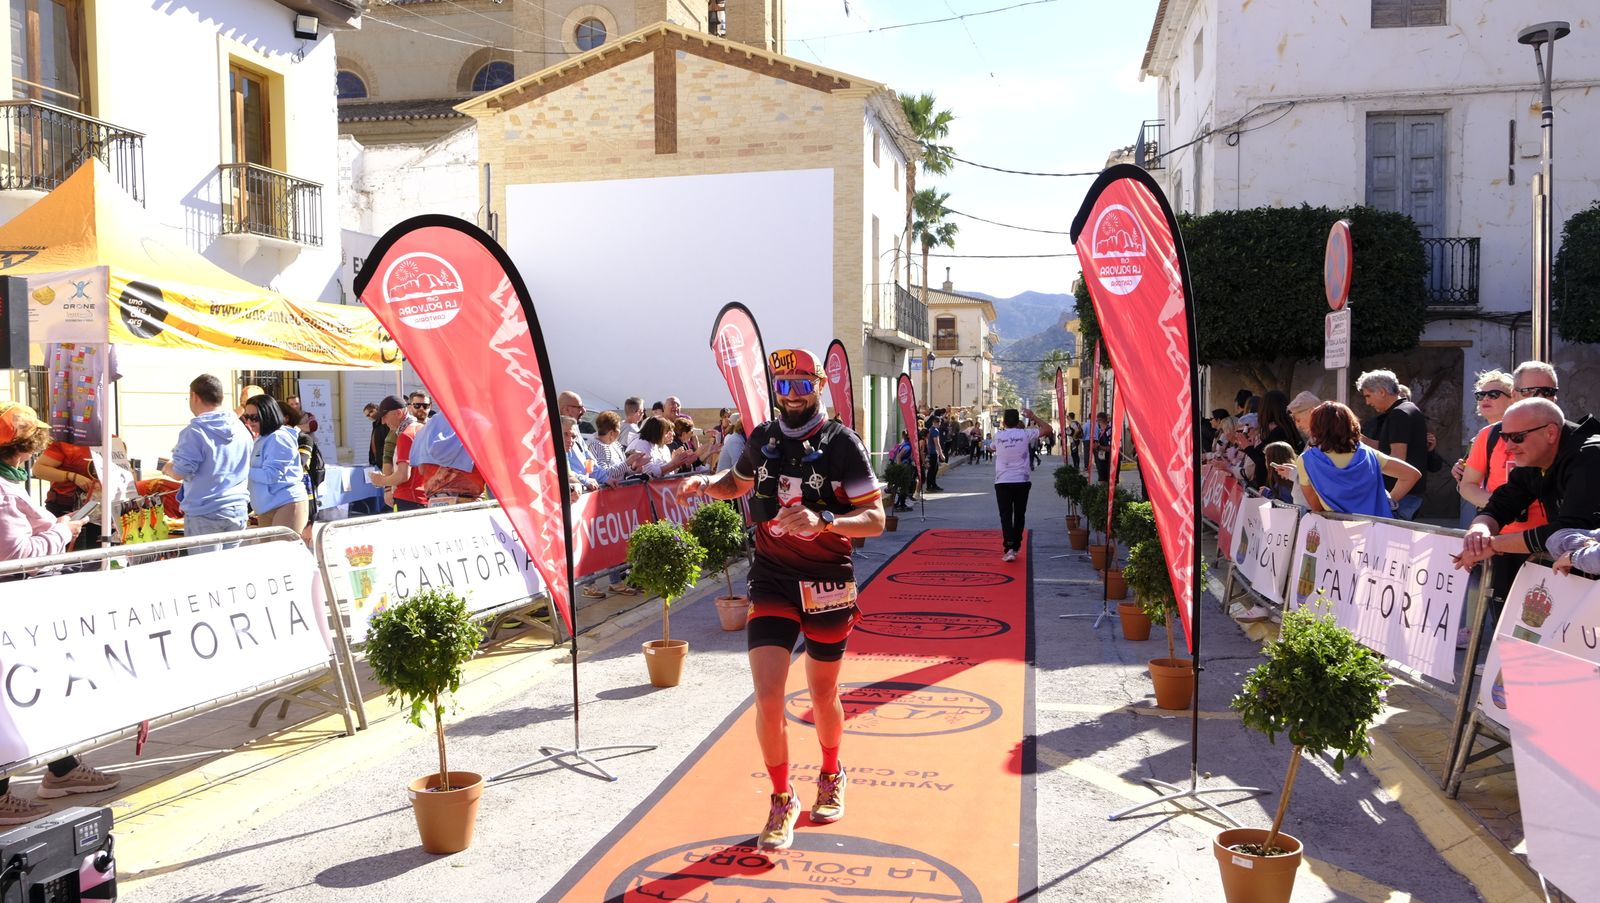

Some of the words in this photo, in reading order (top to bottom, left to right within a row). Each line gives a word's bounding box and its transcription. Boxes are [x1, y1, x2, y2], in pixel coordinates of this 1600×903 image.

[128, 298, 143, 306] uno
[582, 508, 640, 550] VEOLIA
[391, 531, 506, 564] AYUNTAMENTO
[394, 548, 537, 600] CANTORIA
[1435, 572, 1454, 594] DE
[2, 582, 257, 650] AYUNTAMIENTO
[267, 574, 295, 595] DE
[1317, 568, 1450, 642] CANTORIA
[5, 600, 310, 708] CANTORIA
[903, 769, 940, 779] de
[682, 850, 874, 877] POLVORA
[887, 866, 939, 882] LA
